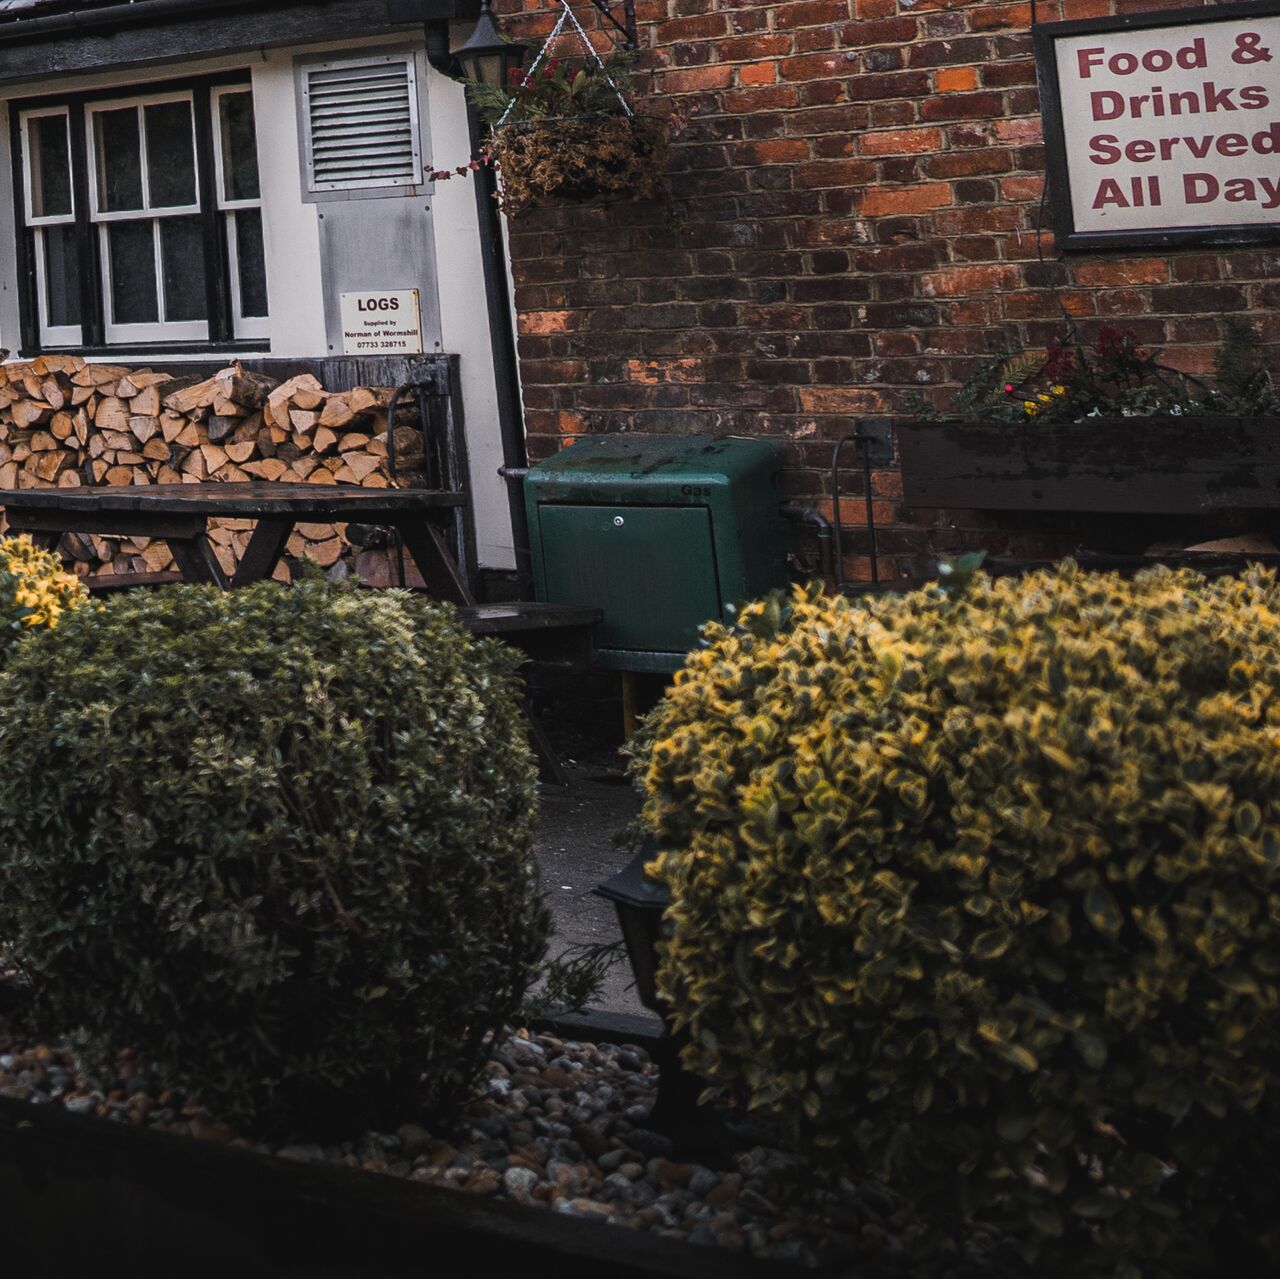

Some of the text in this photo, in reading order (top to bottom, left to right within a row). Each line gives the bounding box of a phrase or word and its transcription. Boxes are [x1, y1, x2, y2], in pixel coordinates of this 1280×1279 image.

[1077, 32, 1274, 79] Food &
[1090, 81, 1270, 121] Drinks
[1089, 122, 1280, 165] Served
[1091, 172, 1280, 210] All Day
[357, 297, 399, 311] LOGS
[357, 341, 379, 349] 07733
[382, 329, 418, 337] Wormshill
[681, 484, 712, 496] Gas
